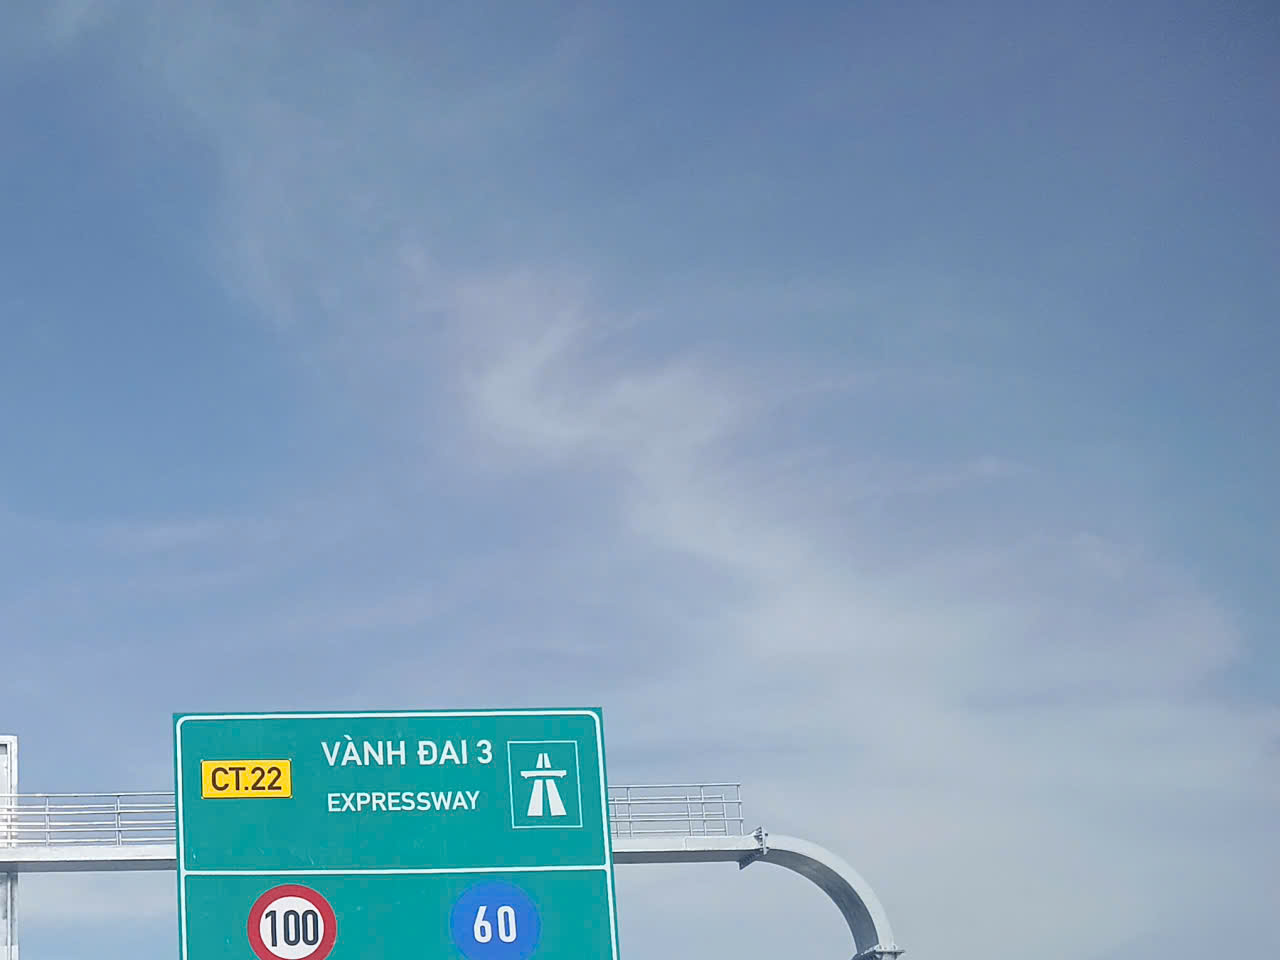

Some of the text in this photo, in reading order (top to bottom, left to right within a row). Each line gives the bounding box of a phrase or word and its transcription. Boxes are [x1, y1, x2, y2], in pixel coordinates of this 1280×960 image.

[321, 734, 494, 767] VÀNH ĐAI 3
[211, 766, 283, 791] CT.22
[327, 790, 480, 813] EXPRESSWAY
[265, 909, 320, 947] 100
[473, 905, 517, 943] 60
